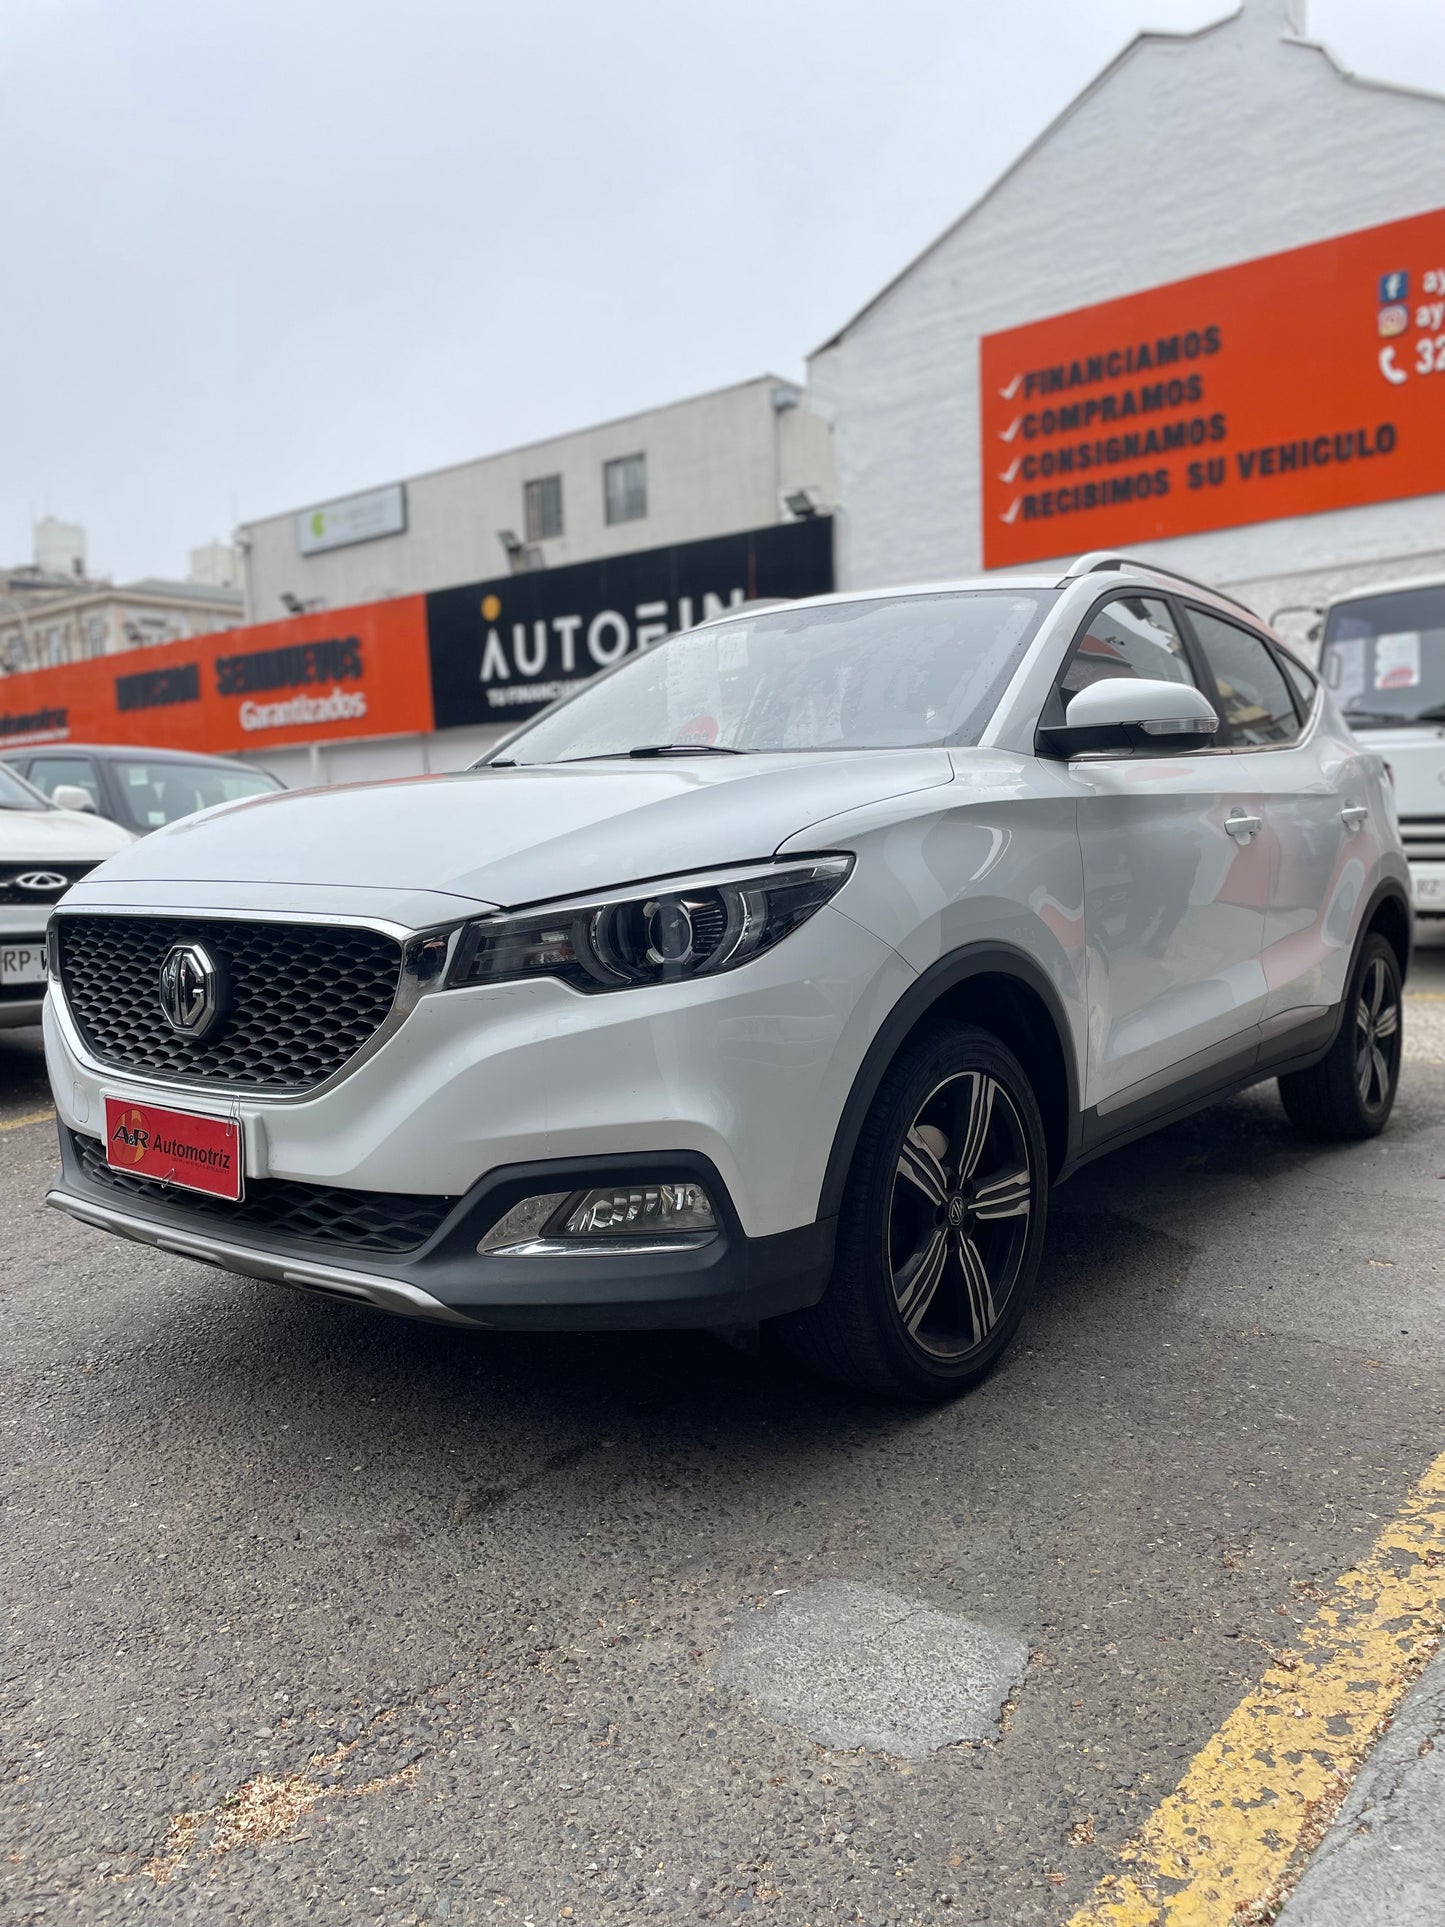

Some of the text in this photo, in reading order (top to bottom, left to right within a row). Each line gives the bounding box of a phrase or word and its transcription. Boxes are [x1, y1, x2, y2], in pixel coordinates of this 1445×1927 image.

[1024, 325, 1221, 398] FINANCIAMOS
[1022, 373, 1203, 439] COMPRAMOS
[1022, 413, 1226, 480] CONSIGNAMOS
[1023, 423, 1396, 520] RECIBIMOS SU VEHICULO
[239, 687, 368, 731] Garantizados
[112, 1126, 149, 1149] A&R
[153, 1134, 231, 1169] Automotriz
